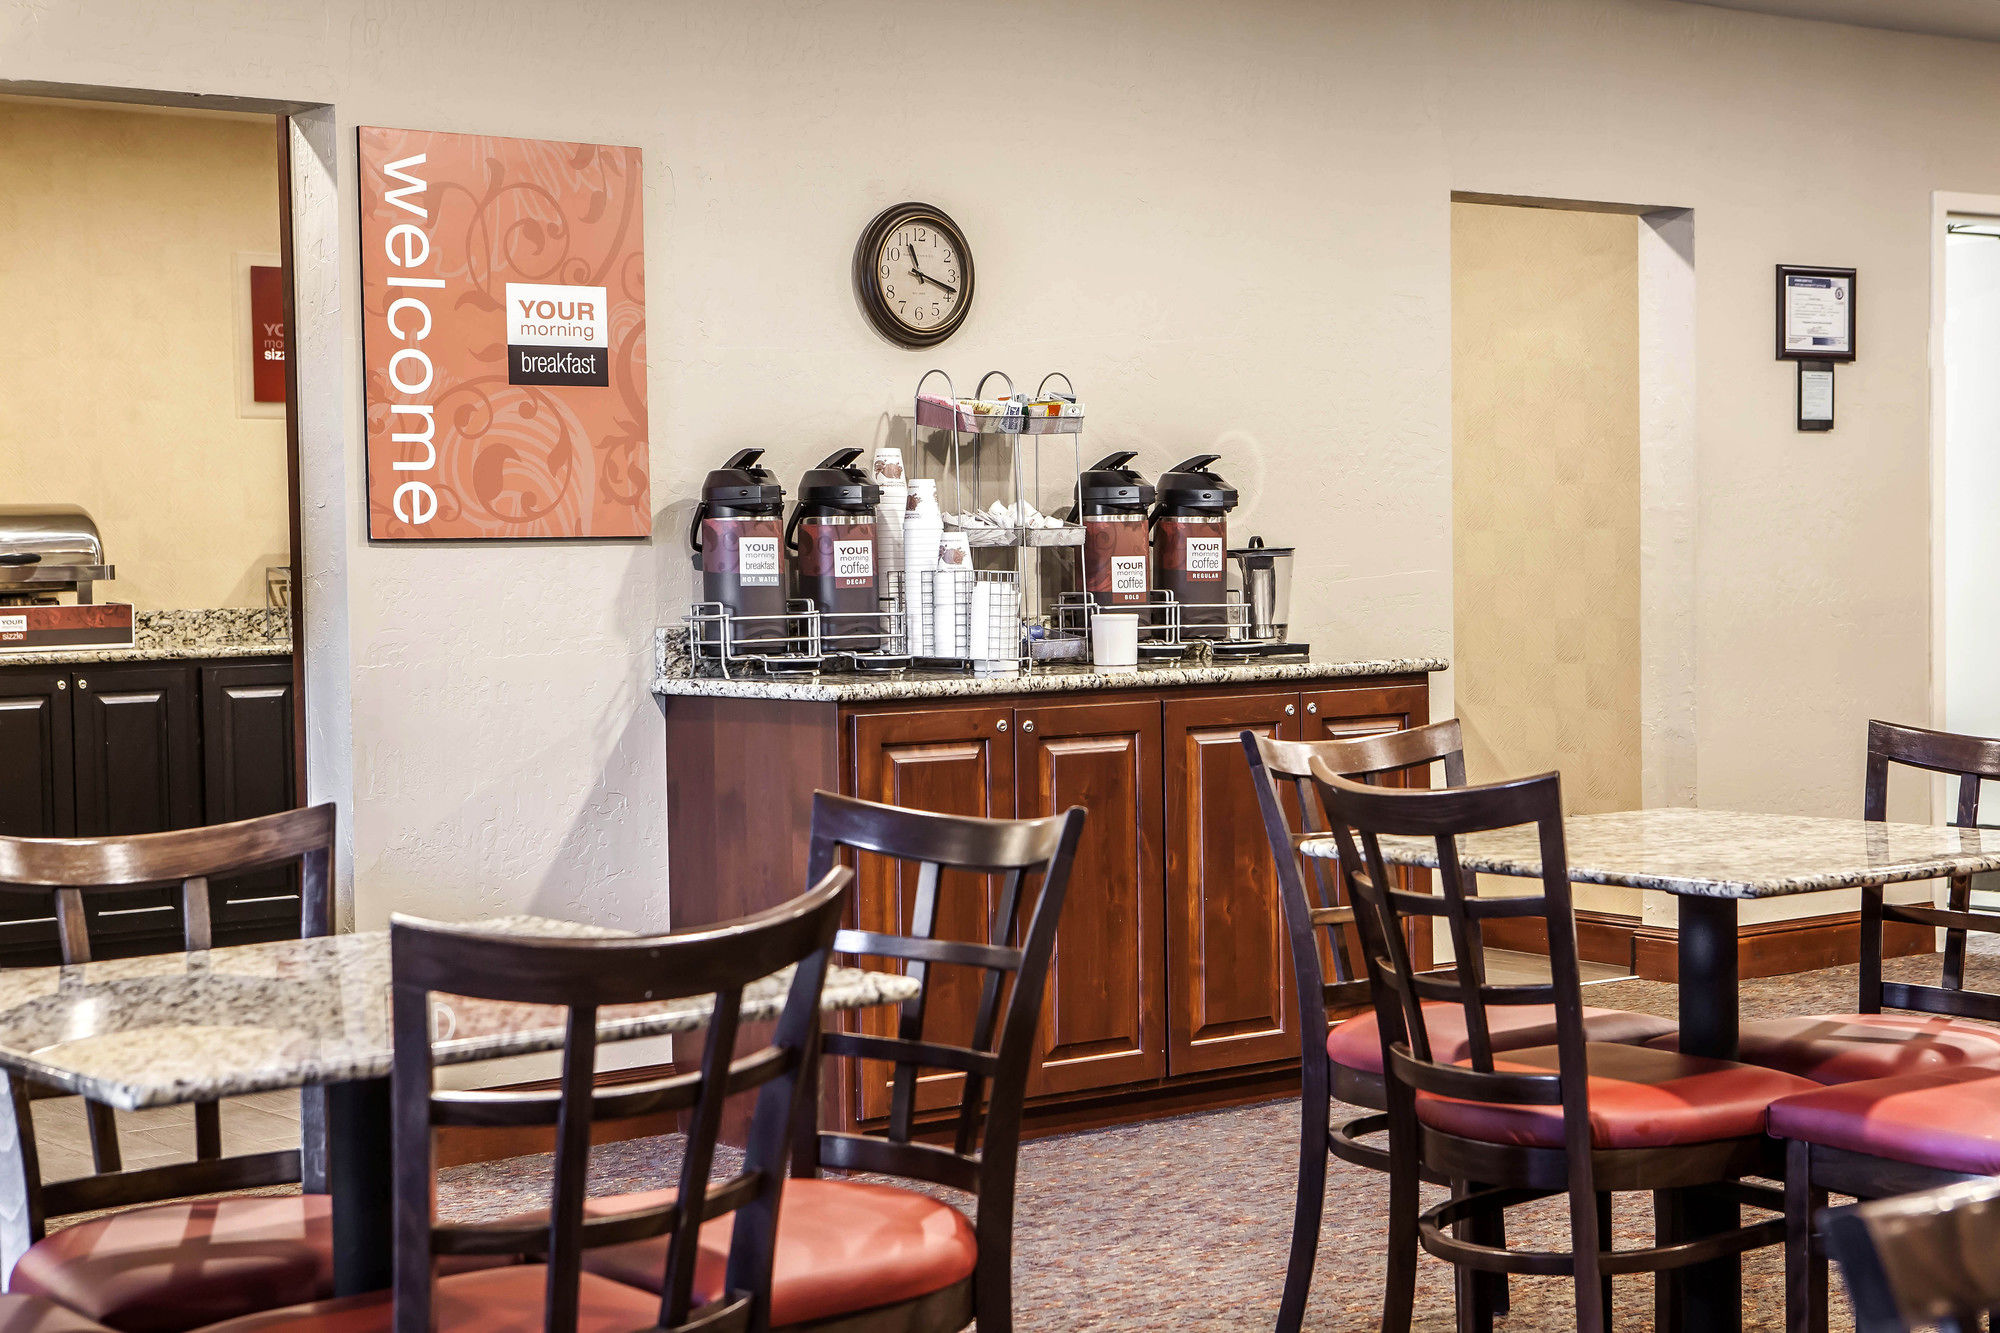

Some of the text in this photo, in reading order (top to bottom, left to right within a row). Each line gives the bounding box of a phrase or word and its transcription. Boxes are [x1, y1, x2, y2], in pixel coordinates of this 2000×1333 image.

[898, 232, 909, 247] 11
[913, 227, 926, 242] 12
[886, 247, 900, 262] 10
[943, 249, 951, 263] 2
[881, 264, 890, 279] 9
[947, 269, 956, 284] 3
[886, 285, 895, 300] 8
[943, 289, 952, 303] 4
[518, 299, 595, 321] YOUR
[898, 300, 907, 314] 7
[914, 306, 924, 321] 6
[931, 303, 940, 317] 5
[520, 322, 594, 341] morning
[384, 153, 446, 525] welcome
[521, 351, 597, 375] breakfast
[745, 543, 775, 552] YOUR
[839, 546, 869, 555] YOUR
[1191, 543, 1219, 551] YOUR
[745, 552, 775, 560] morning
[1191, 556, 1219, 569] coffee
[745, 561, 776, 570] breakfast
[840, 561, 870, 575] coffee
[1116, 562, 1144, 570] YOUR
[1117, 576, 1144, 589] coffee
[1, 631, 24, 640] sizzle
